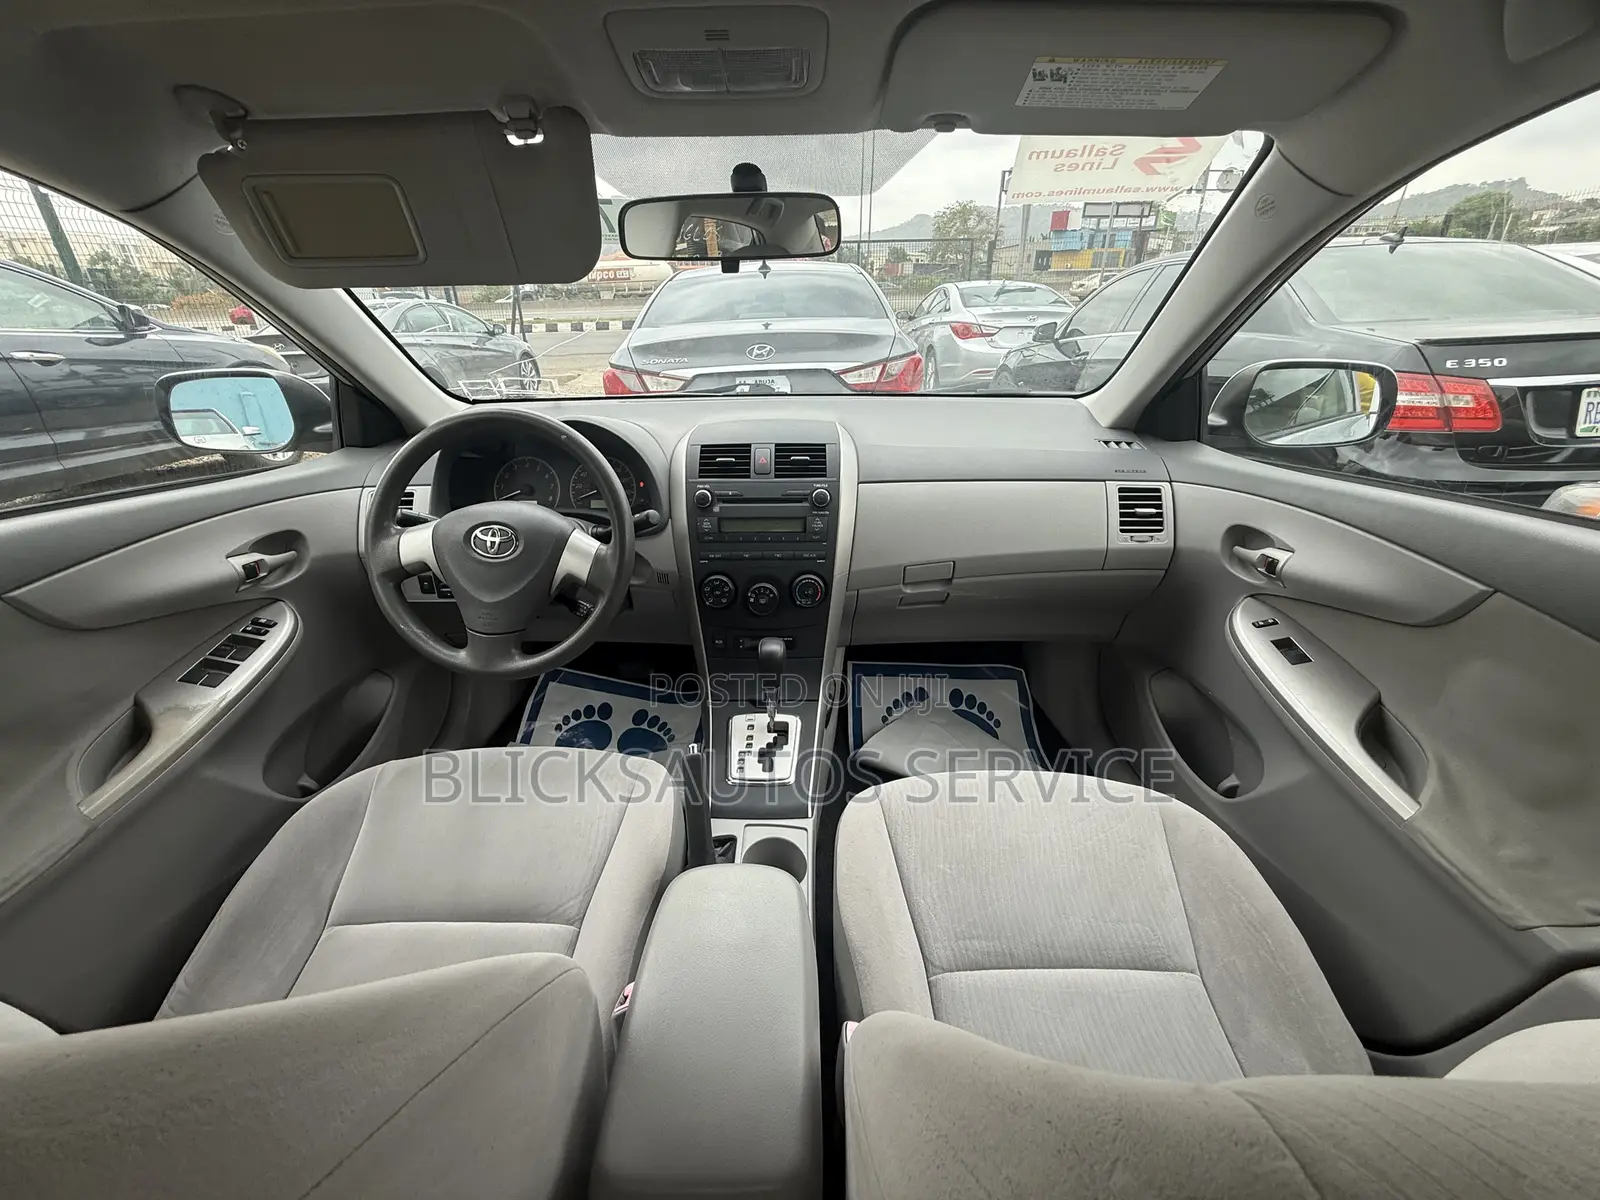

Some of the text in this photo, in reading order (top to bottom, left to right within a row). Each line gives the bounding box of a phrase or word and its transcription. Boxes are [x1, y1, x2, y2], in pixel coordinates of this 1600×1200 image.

[641, 357, 689, 365] SONATA
[1445, 357, 1508, 368] E 350
